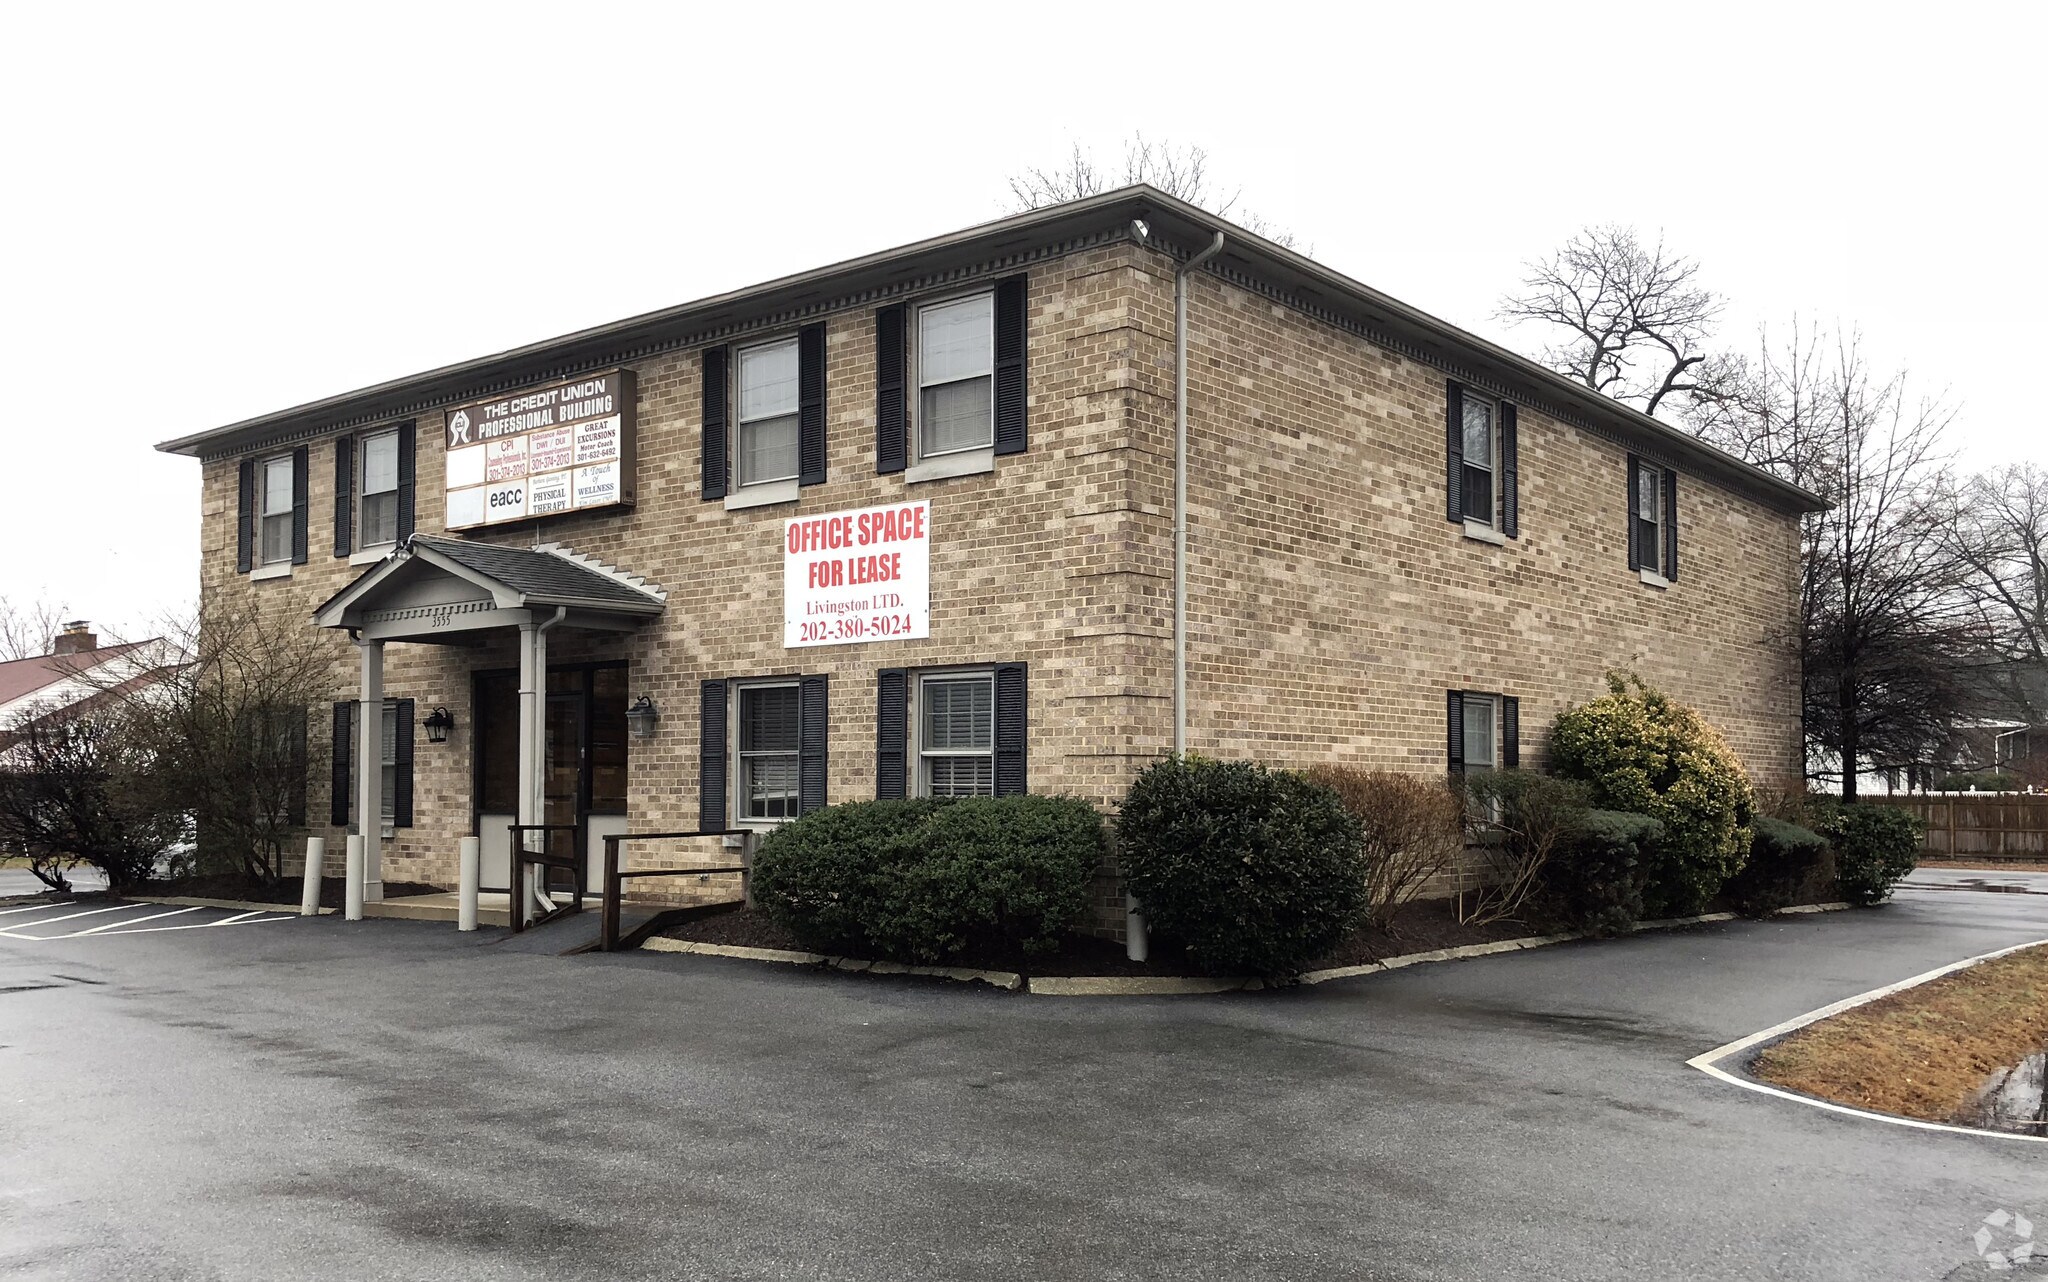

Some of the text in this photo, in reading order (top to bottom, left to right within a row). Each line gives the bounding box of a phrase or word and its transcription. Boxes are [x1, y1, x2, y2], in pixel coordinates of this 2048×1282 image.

[484, 379, 606, 419] THE CREDIT UNION
[478, 395, 612, 440] PROFESSIONAL BUILDING
[584, 420, 608, 432] GREAT
[536, 440, 548, 450] DWI
[555, 437, 566, 446] DUI
[578, 429, 616, 444] EXCURSIONS
[598, 440, 614, 448] Coach
[500, 440, 514, 452] CPI
[532, 453, 570, 470] 301-374-2013
[581, 463, 611, 478] A Touch
[533, 489, 566, 502] PHYSICAL
[578, 483, 614, 496] WELLNESS
[490, 488, 522, 508] eacc
[533, 500, 566, 514] THERAPY
[788, 506, 924, 554] OFFICE SPACE
[809, 552, 900, 588] FOR LEASE
[806, 600, 868, 616] Livingston
[432, 614, 450, 627] 3555
[800, 613, 912, 642] 202-380-5024
